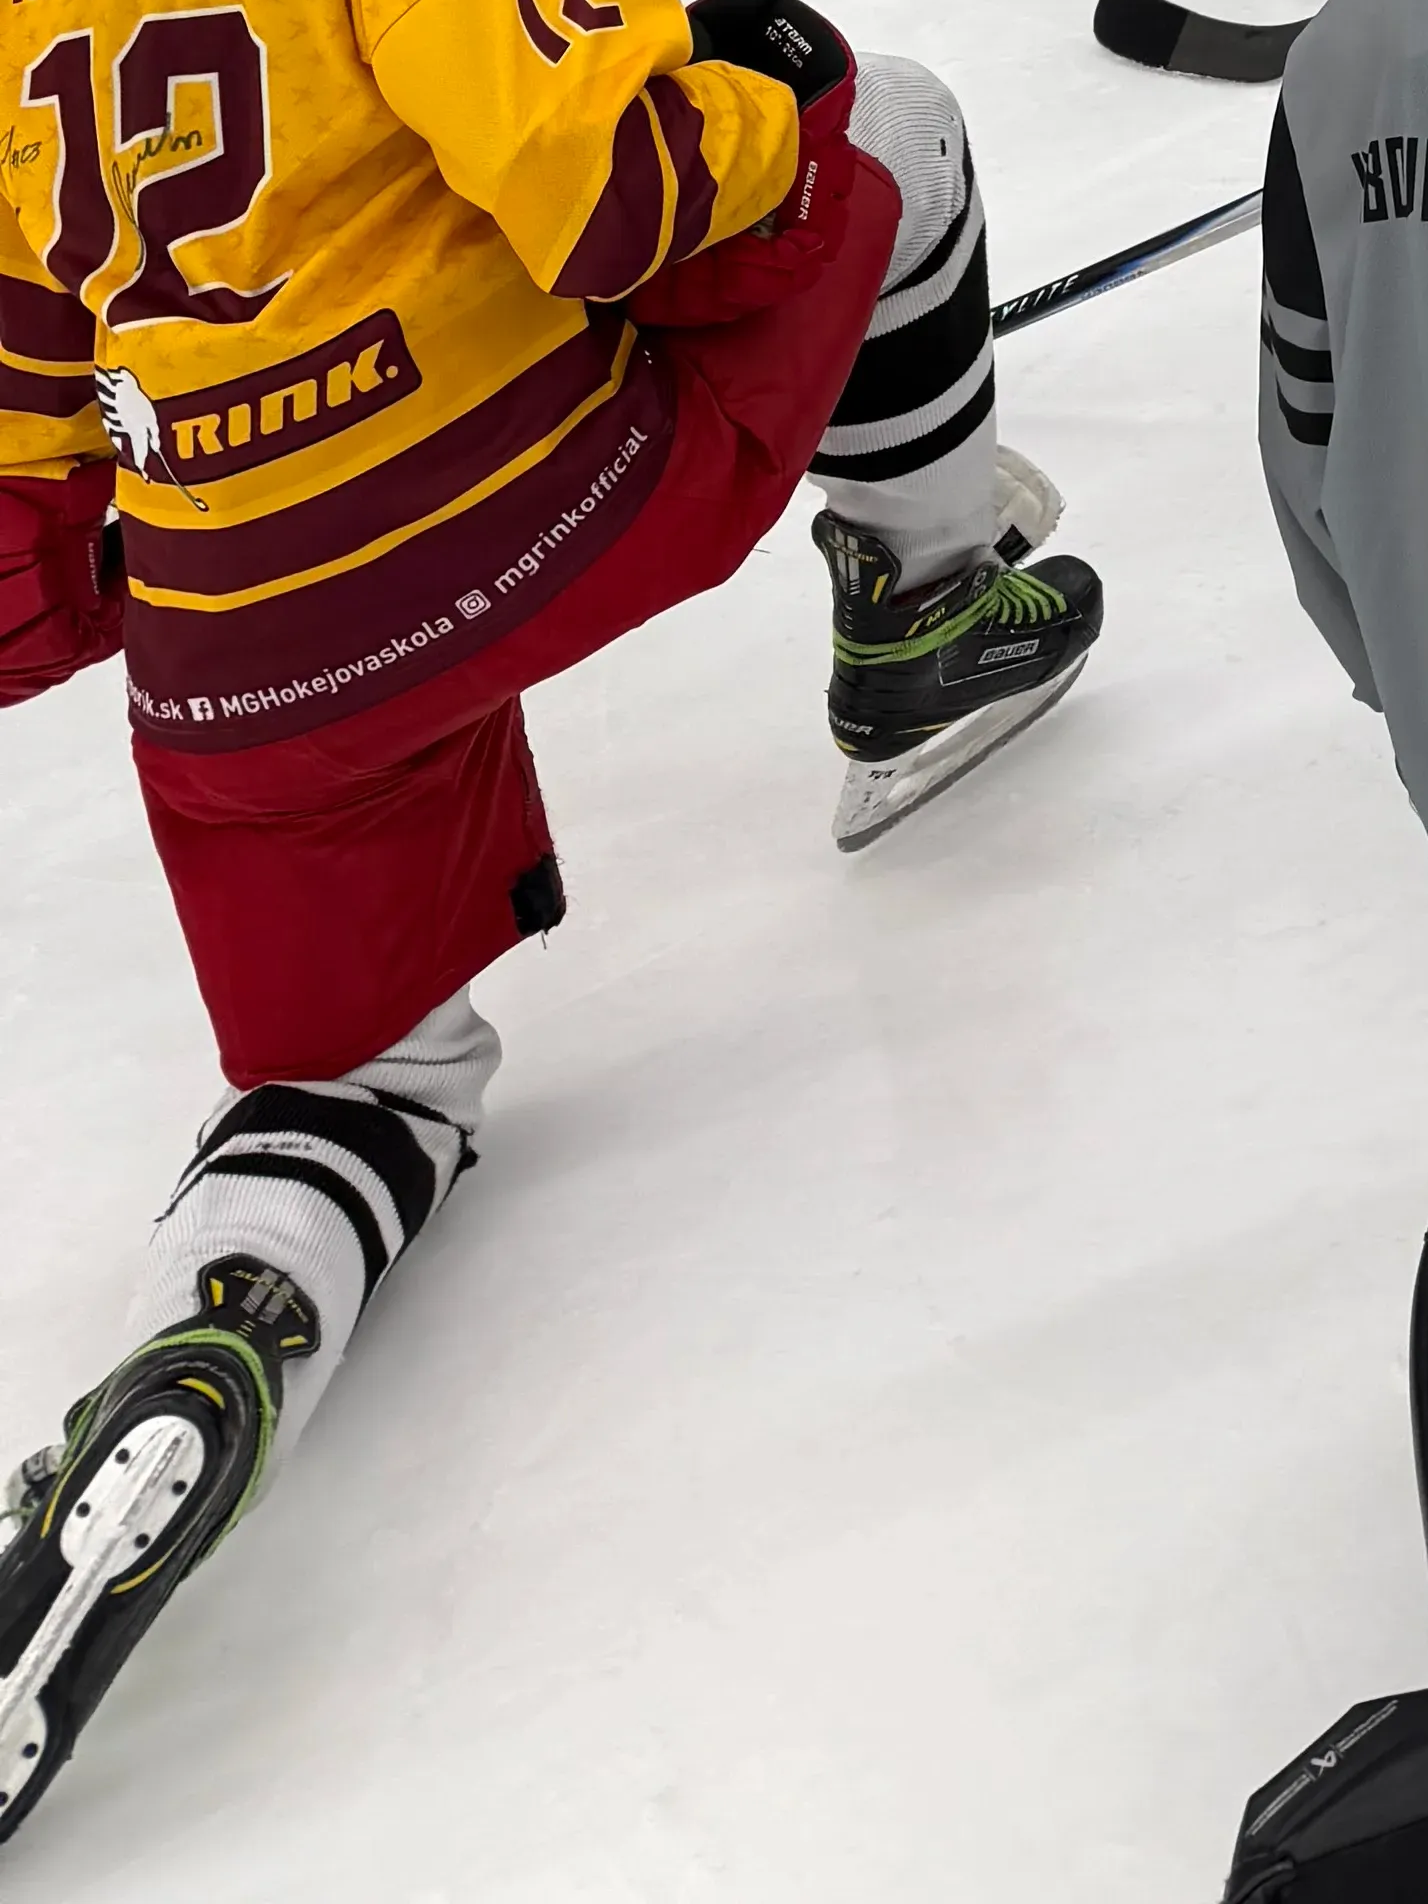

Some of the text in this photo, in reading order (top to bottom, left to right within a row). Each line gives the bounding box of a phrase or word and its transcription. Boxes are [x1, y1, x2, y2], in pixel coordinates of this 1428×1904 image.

[19, 5, 297, 332] 12
[798, 160, 818, 221] BAUER
[170, 336, 400, 463] RINK.
[493, 426, 649, 595] mgrinkofficial
[219, 616, 455, 721] MGHokejovaskola
